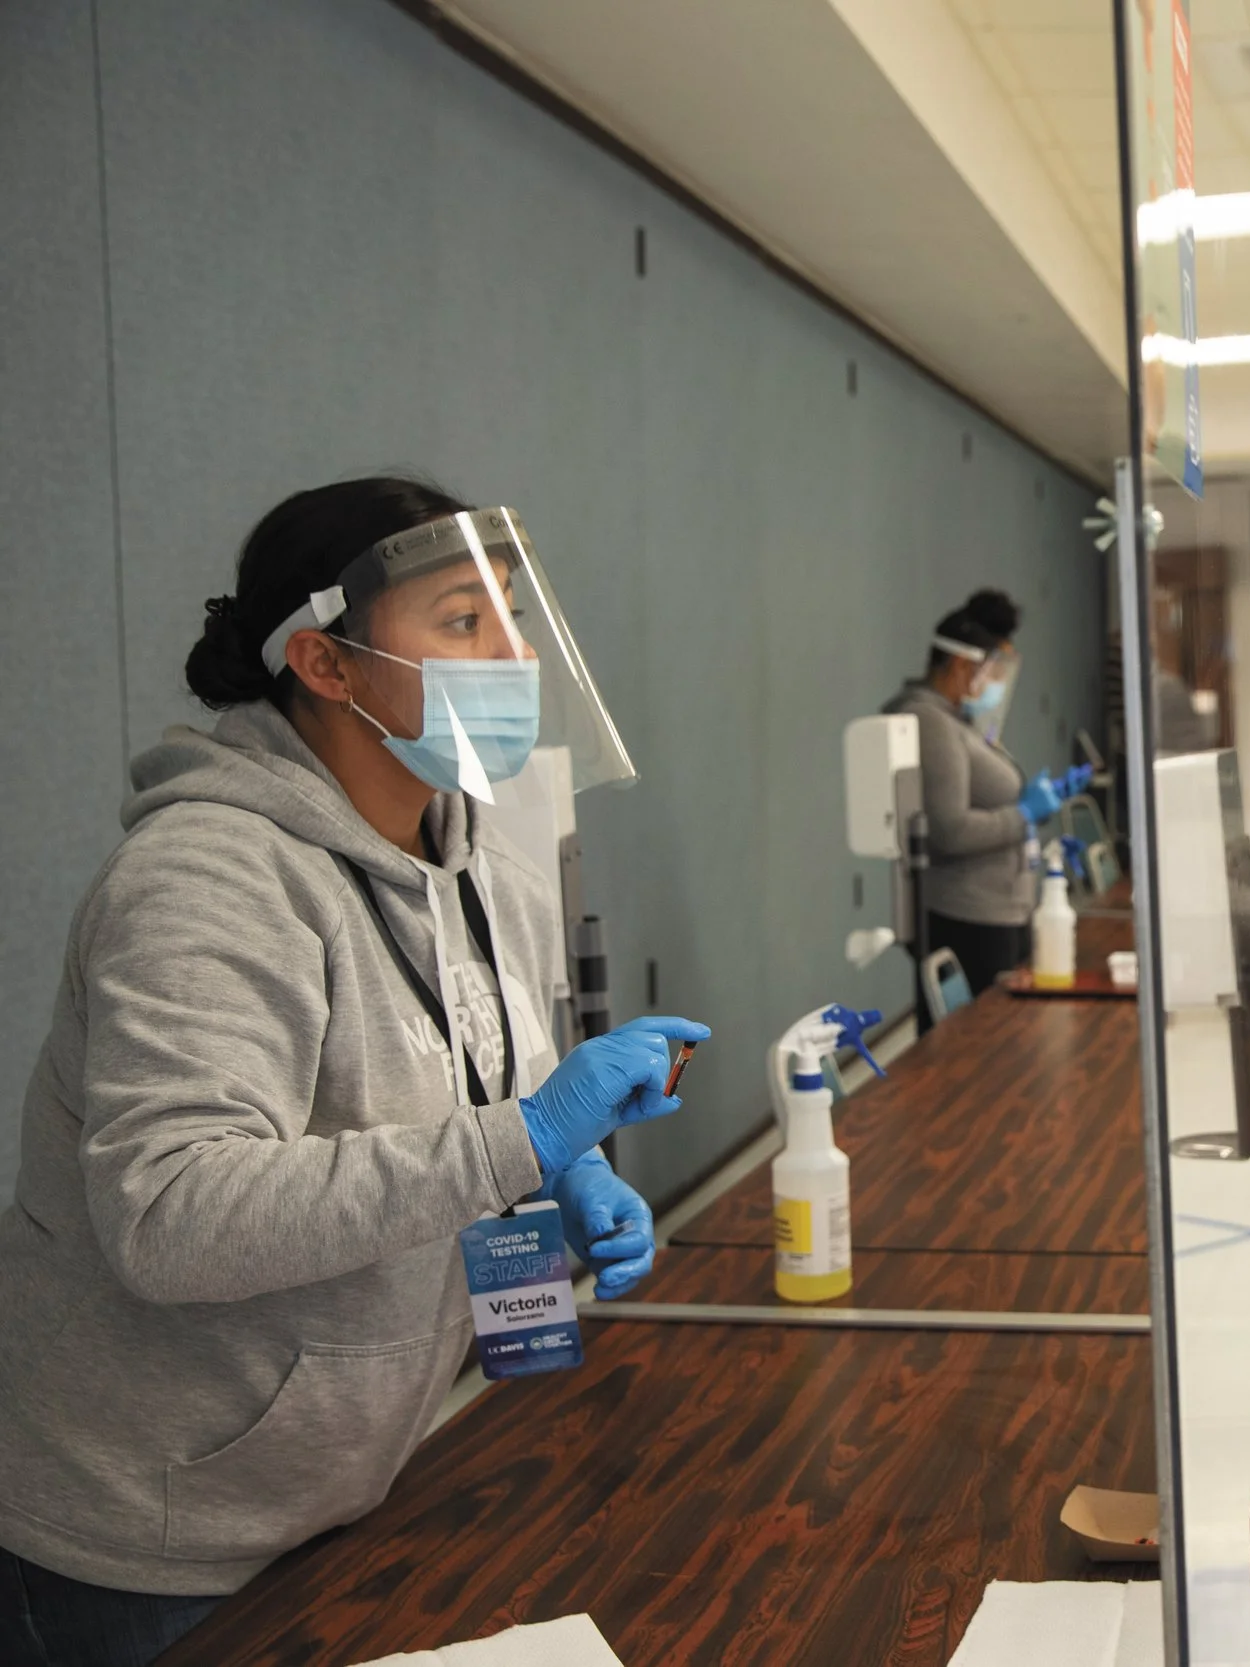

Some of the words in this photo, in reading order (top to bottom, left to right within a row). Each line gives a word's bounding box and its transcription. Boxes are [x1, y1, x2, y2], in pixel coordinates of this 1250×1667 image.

[440, 1033, 504, 1093] FCE
[486, 1230, 540, 1248] COVID-19
[490, 1242, 540, 1258] TESTING
[473, 1252, 562, 1285] STAFF
[488, 1293, 558, 1315] Victoria
